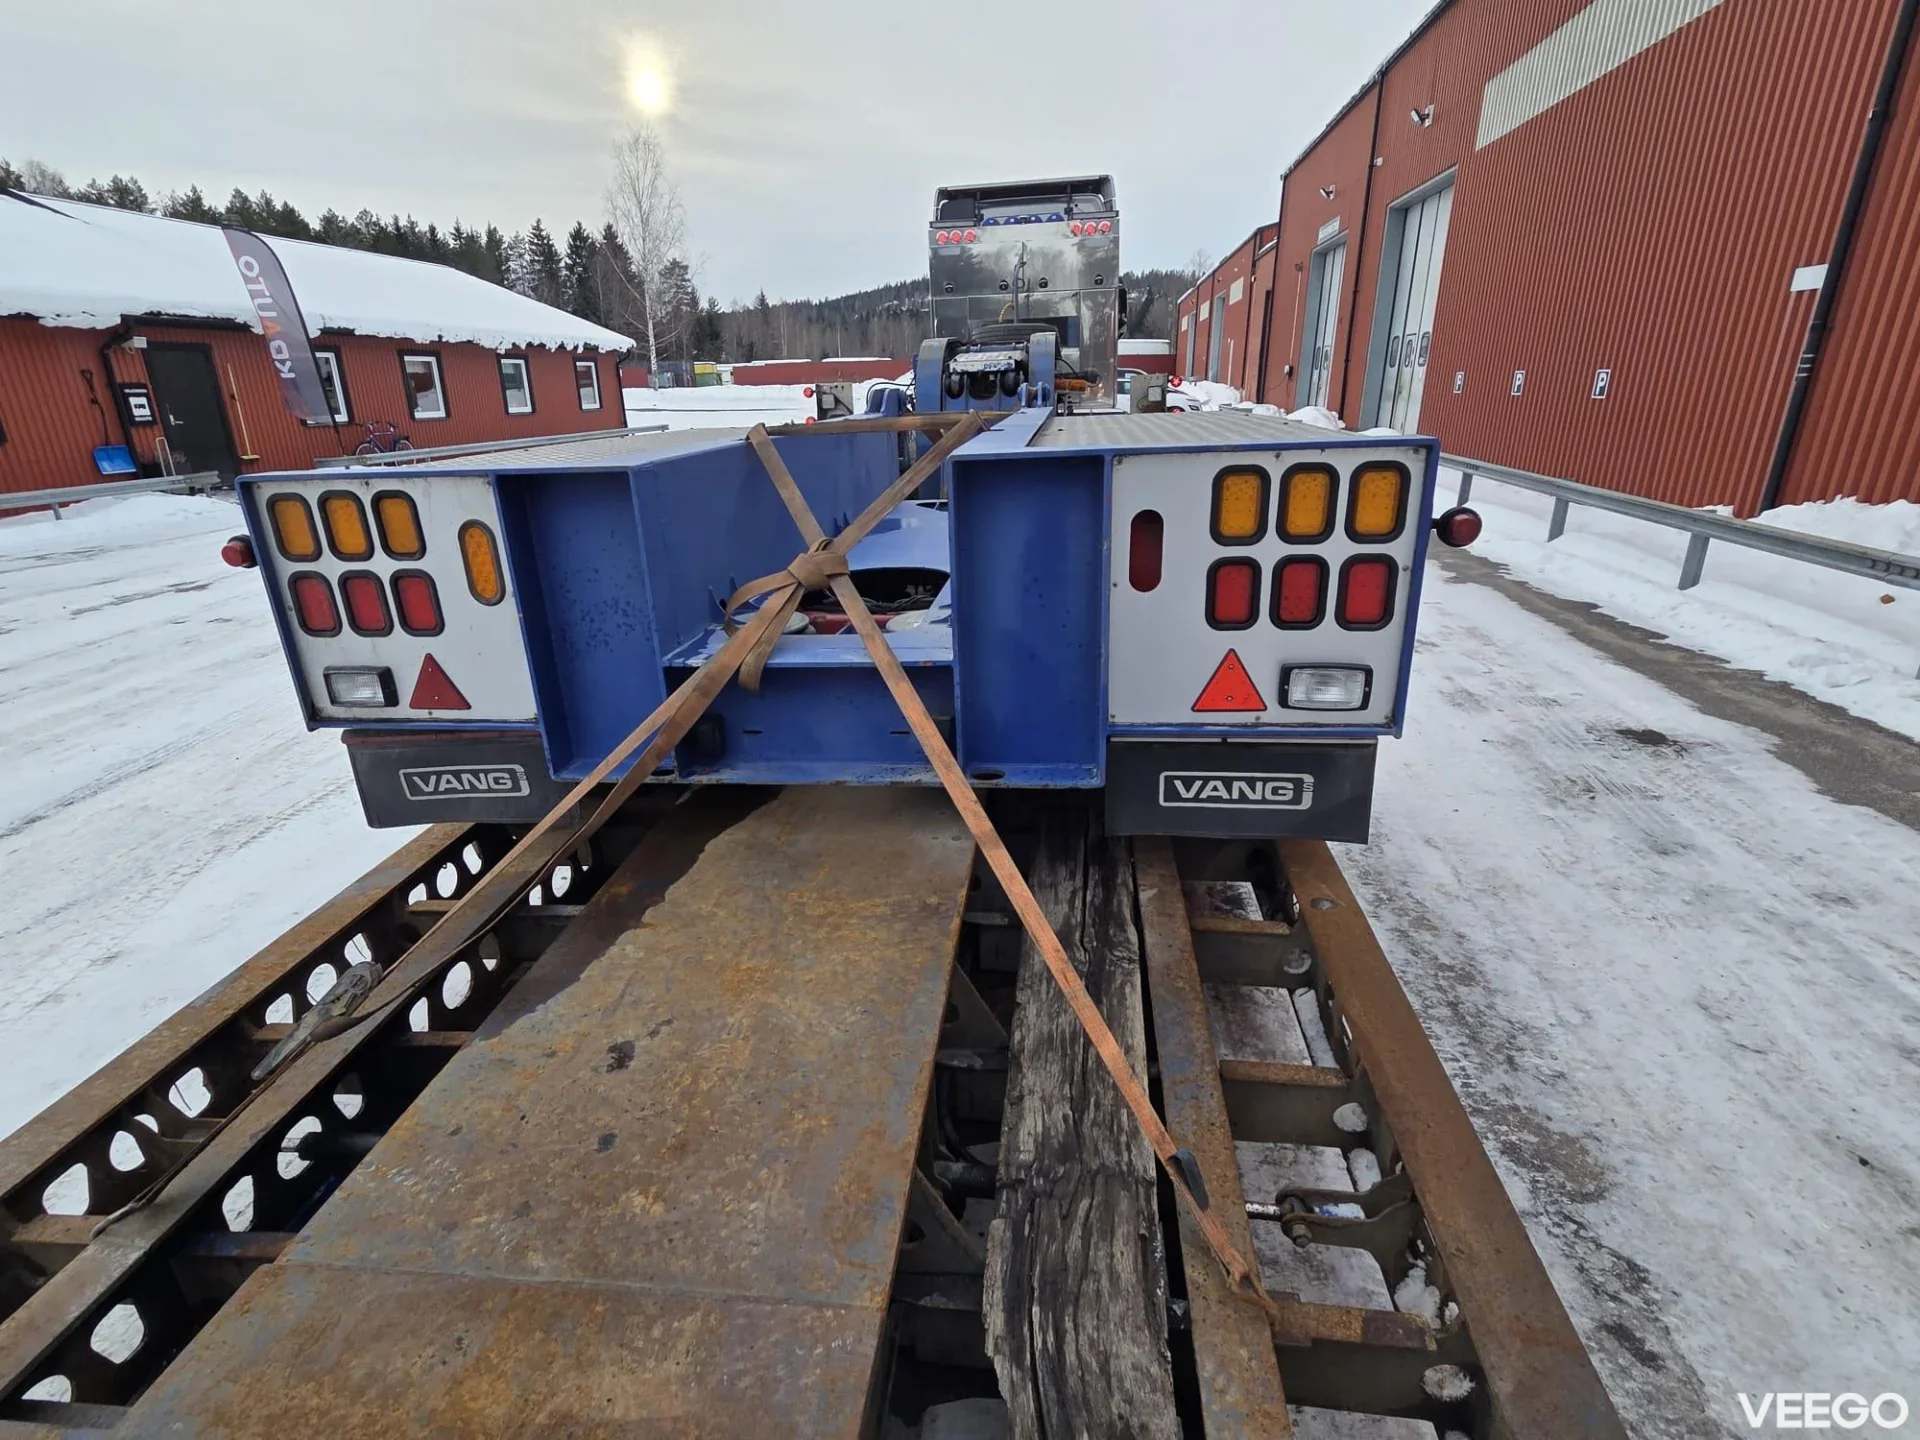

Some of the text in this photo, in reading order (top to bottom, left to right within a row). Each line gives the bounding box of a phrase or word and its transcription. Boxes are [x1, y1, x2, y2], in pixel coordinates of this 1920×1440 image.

[1595, 372, 1608, 395] P
[412, 772, 513, 792] VANG
[1173, 780, 1294, 801] VANG
